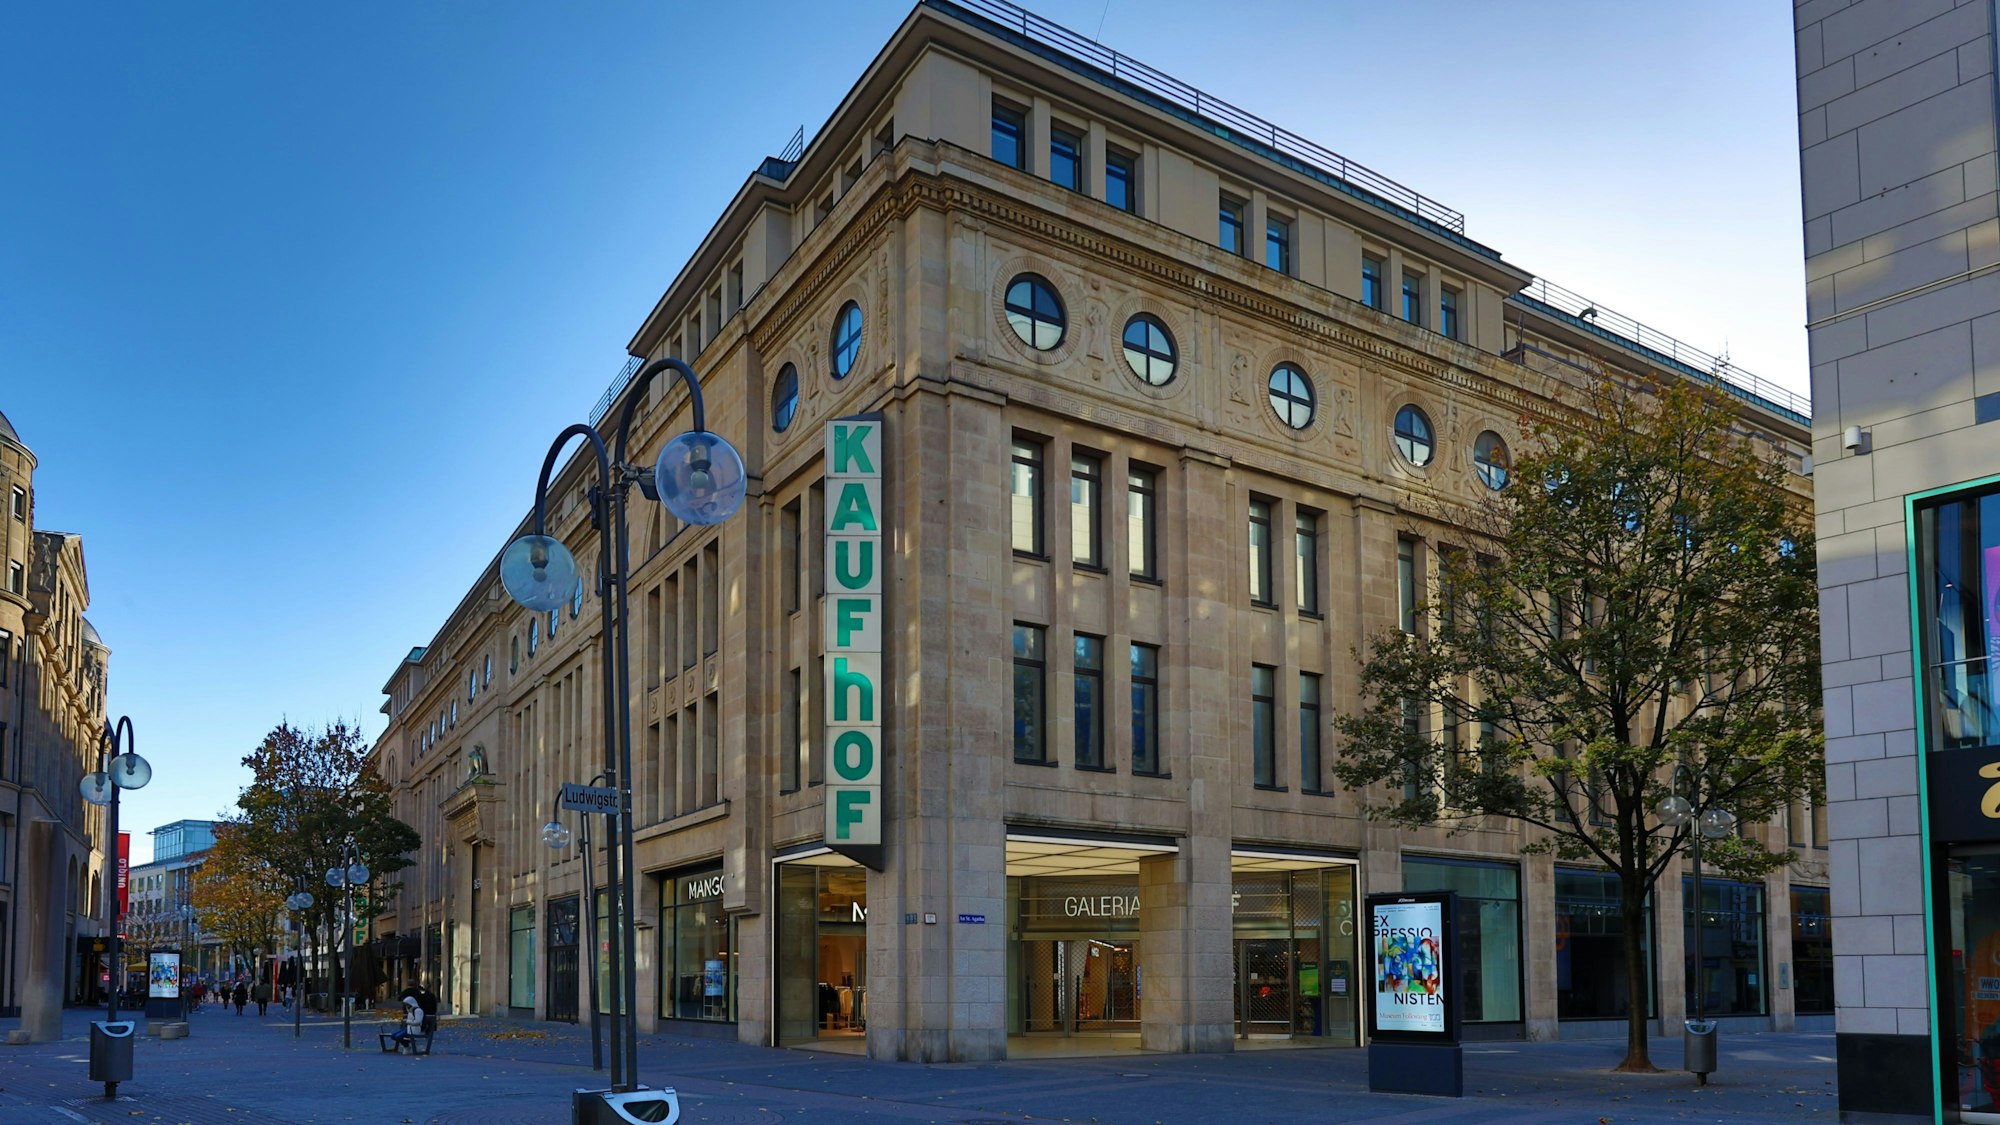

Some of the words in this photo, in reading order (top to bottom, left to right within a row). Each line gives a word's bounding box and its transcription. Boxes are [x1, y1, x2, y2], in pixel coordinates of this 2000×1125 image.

[565, 787, 618, 809] Ludwigstr.
[118, 858, 128, 888] UNIQLO
[1064, 896, 1140, 916] GALERIA
[1374, 915, 1389, 927] EX
[1394, 993, 1445, 1005] NISTEN
